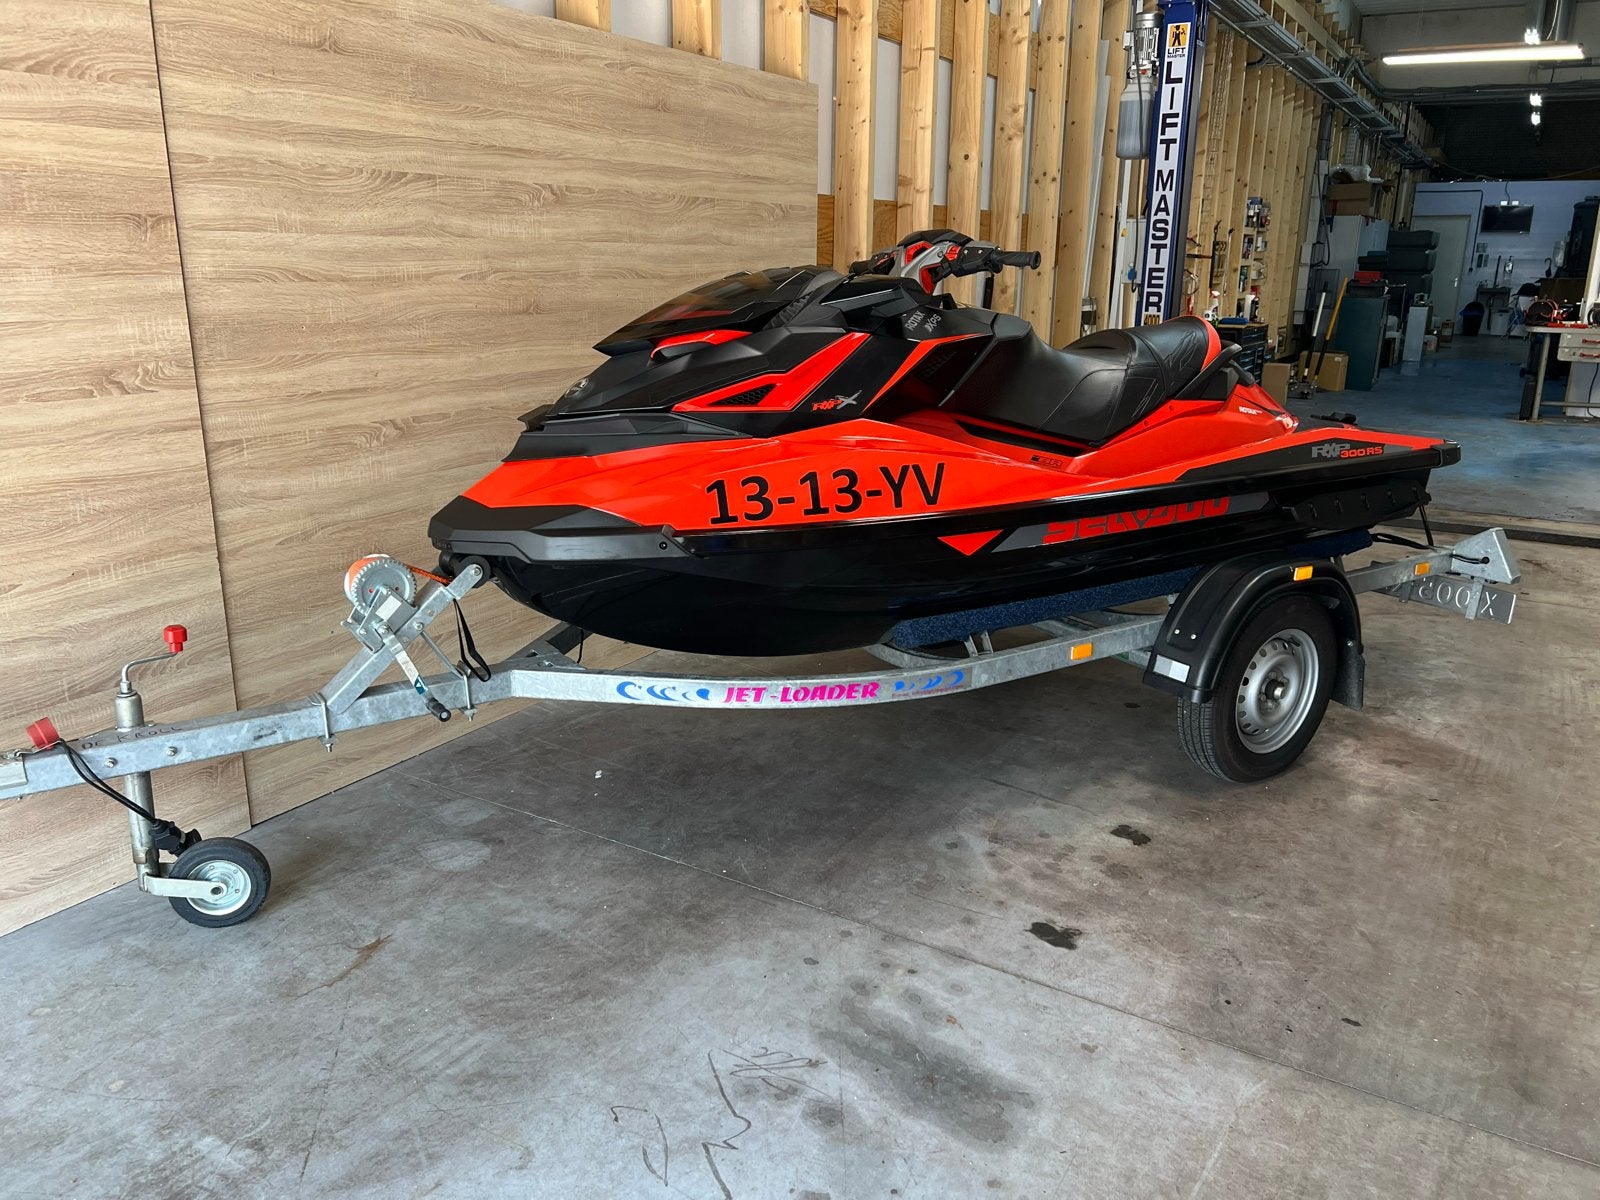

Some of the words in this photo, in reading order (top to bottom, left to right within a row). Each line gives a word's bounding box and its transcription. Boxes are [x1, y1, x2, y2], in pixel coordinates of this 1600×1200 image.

[1159, 61, 1183, 161] LIFT
[1144, 169, 1174, 313] MASTER
[905, 310, 925, 331] ROTAX
[1311, 443, 1350, 458] RXP
[706, 462, 945, 524] 13-13-YV
